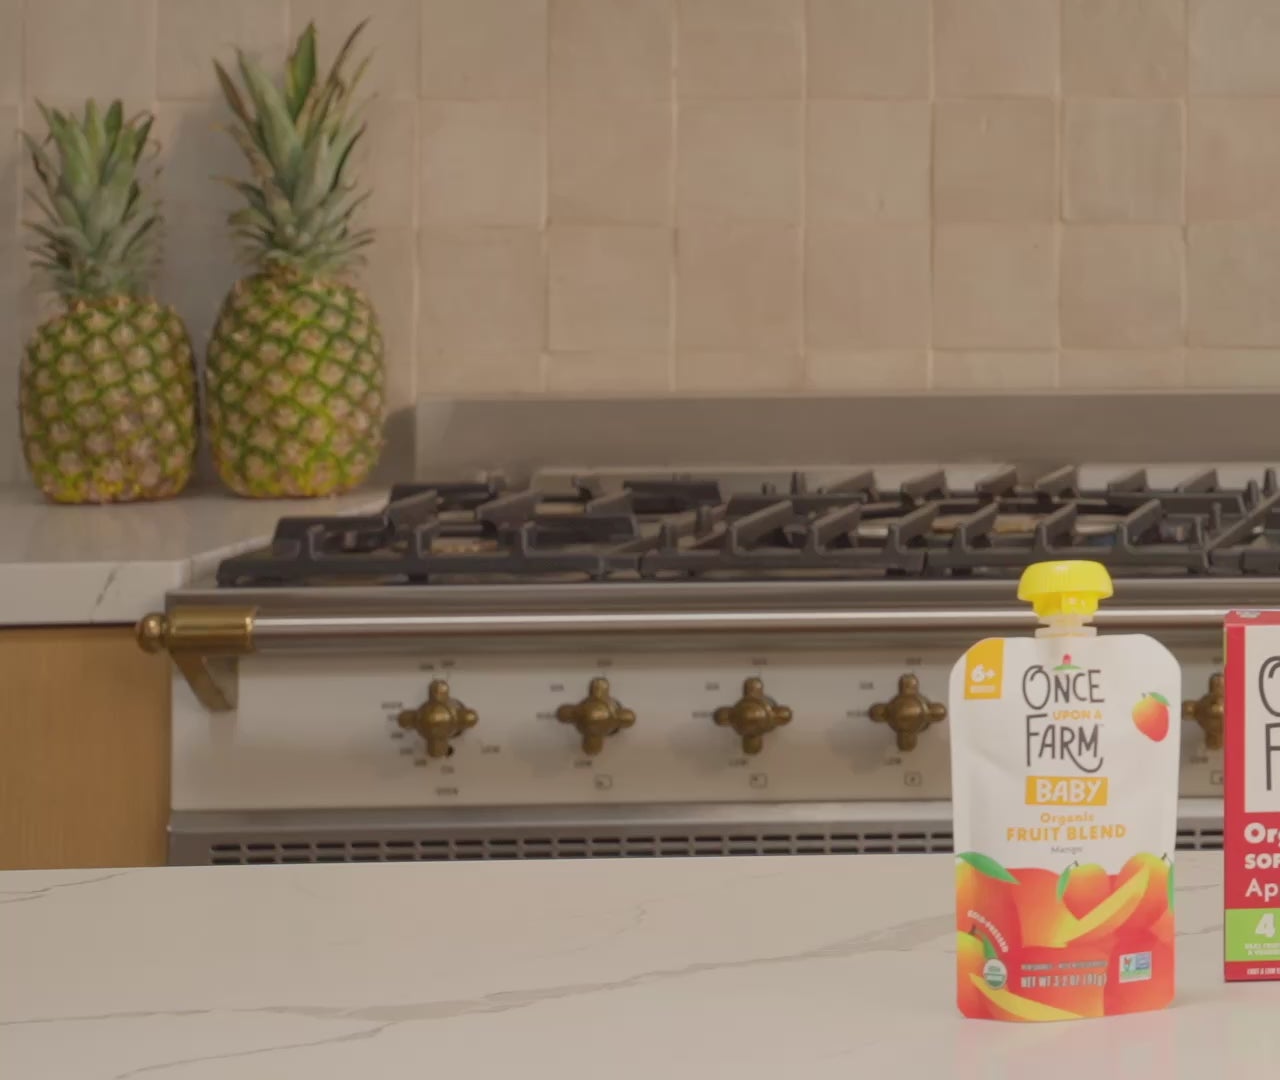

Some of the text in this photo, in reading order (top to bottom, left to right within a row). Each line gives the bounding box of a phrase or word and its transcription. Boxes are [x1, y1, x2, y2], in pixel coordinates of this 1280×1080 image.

[1022, 665, 1105, 709] ONCE
[1053, 710, 1103, 720] UPON A
[1035, 779, 1102, 803] BABY
[1040, 812, 1094, 825] Organic
[1007, 824, 1126, 841] FRUIT BLEND
[1254, 913, 1276, 938] 4
